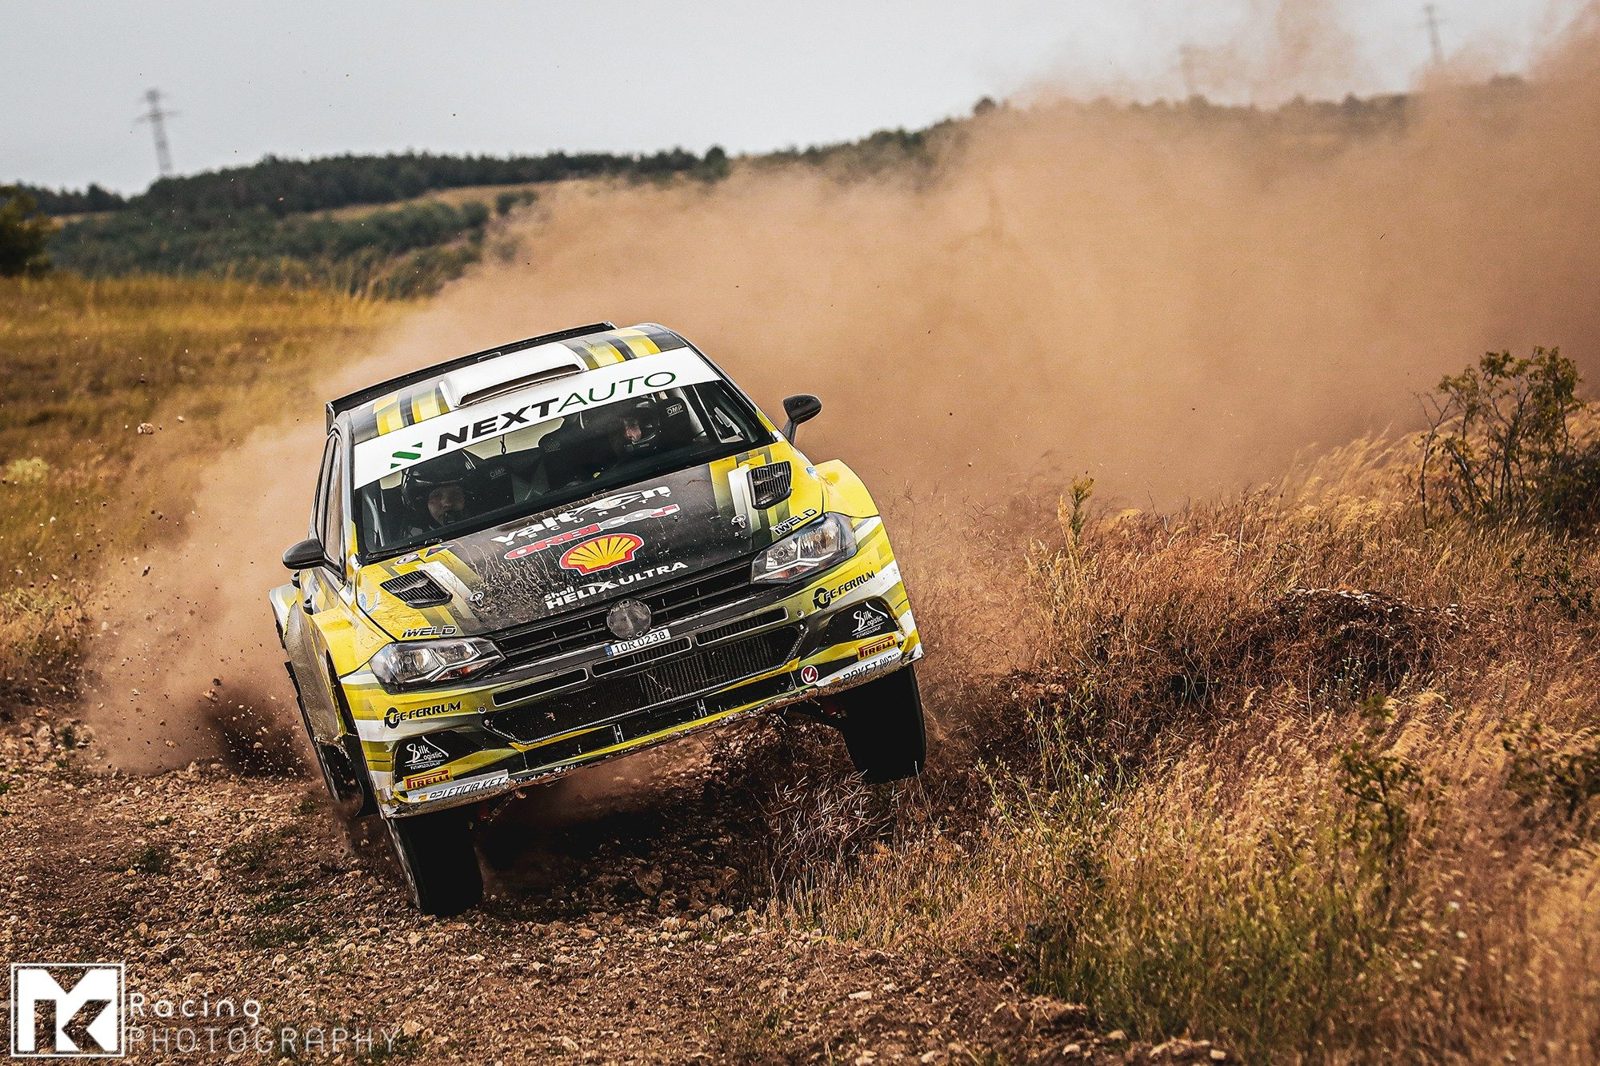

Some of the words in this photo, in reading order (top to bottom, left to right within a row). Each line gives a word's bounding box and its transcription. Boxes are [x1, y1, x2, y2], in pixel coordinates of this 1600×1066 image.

[437, 371, 677, 451] NEXTAUTO
[666, 404, 683, 416] OMP
[544, 586, 575, 601] Shell
[545, 580, 619, 610] HELIX
[618, 561, 689, 586] ULTRA
[637, 631, 666, 647] 0238
[858, 635, 896, 658] PIRELLI
[406, 769, 450, 789] PIRELLI
